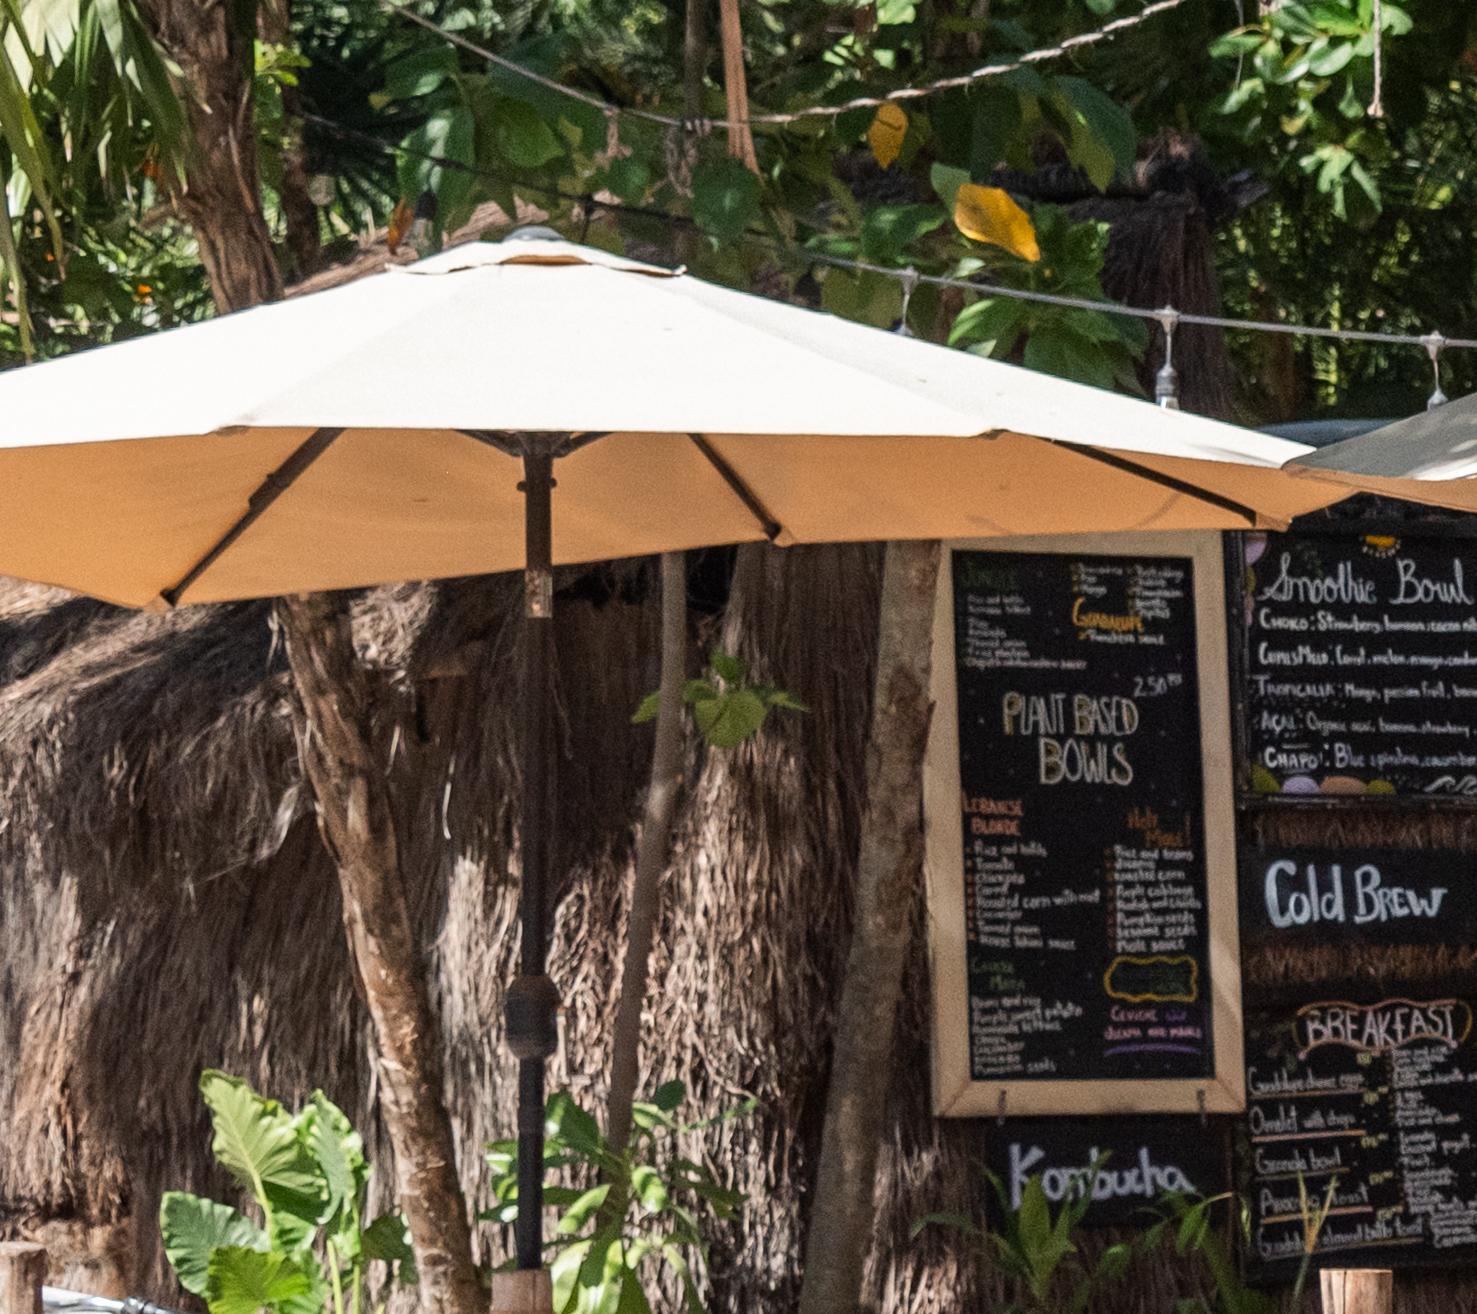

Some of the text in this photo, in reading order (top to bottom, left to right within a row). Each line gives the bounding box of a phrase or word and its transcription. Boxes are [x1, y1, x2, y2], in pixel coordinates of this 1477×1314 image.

[1257, 552, 1377, 605] Smoothie
[1388, 558, 1475, 606] Bowl
[1002, 690, 1140, 736] PLANT BASED
[1038, 737, 1134, 787] BOWLS
[1334, 742, 1365, 769] Blue
[1263, 859, 1345, 929] Cold
[1305, 1006, 1455, 1047] BREAKFAST
[1008, 1142, 1198, 1213] Kombucha
[1308, 1145, 1342, 1170] bowl
